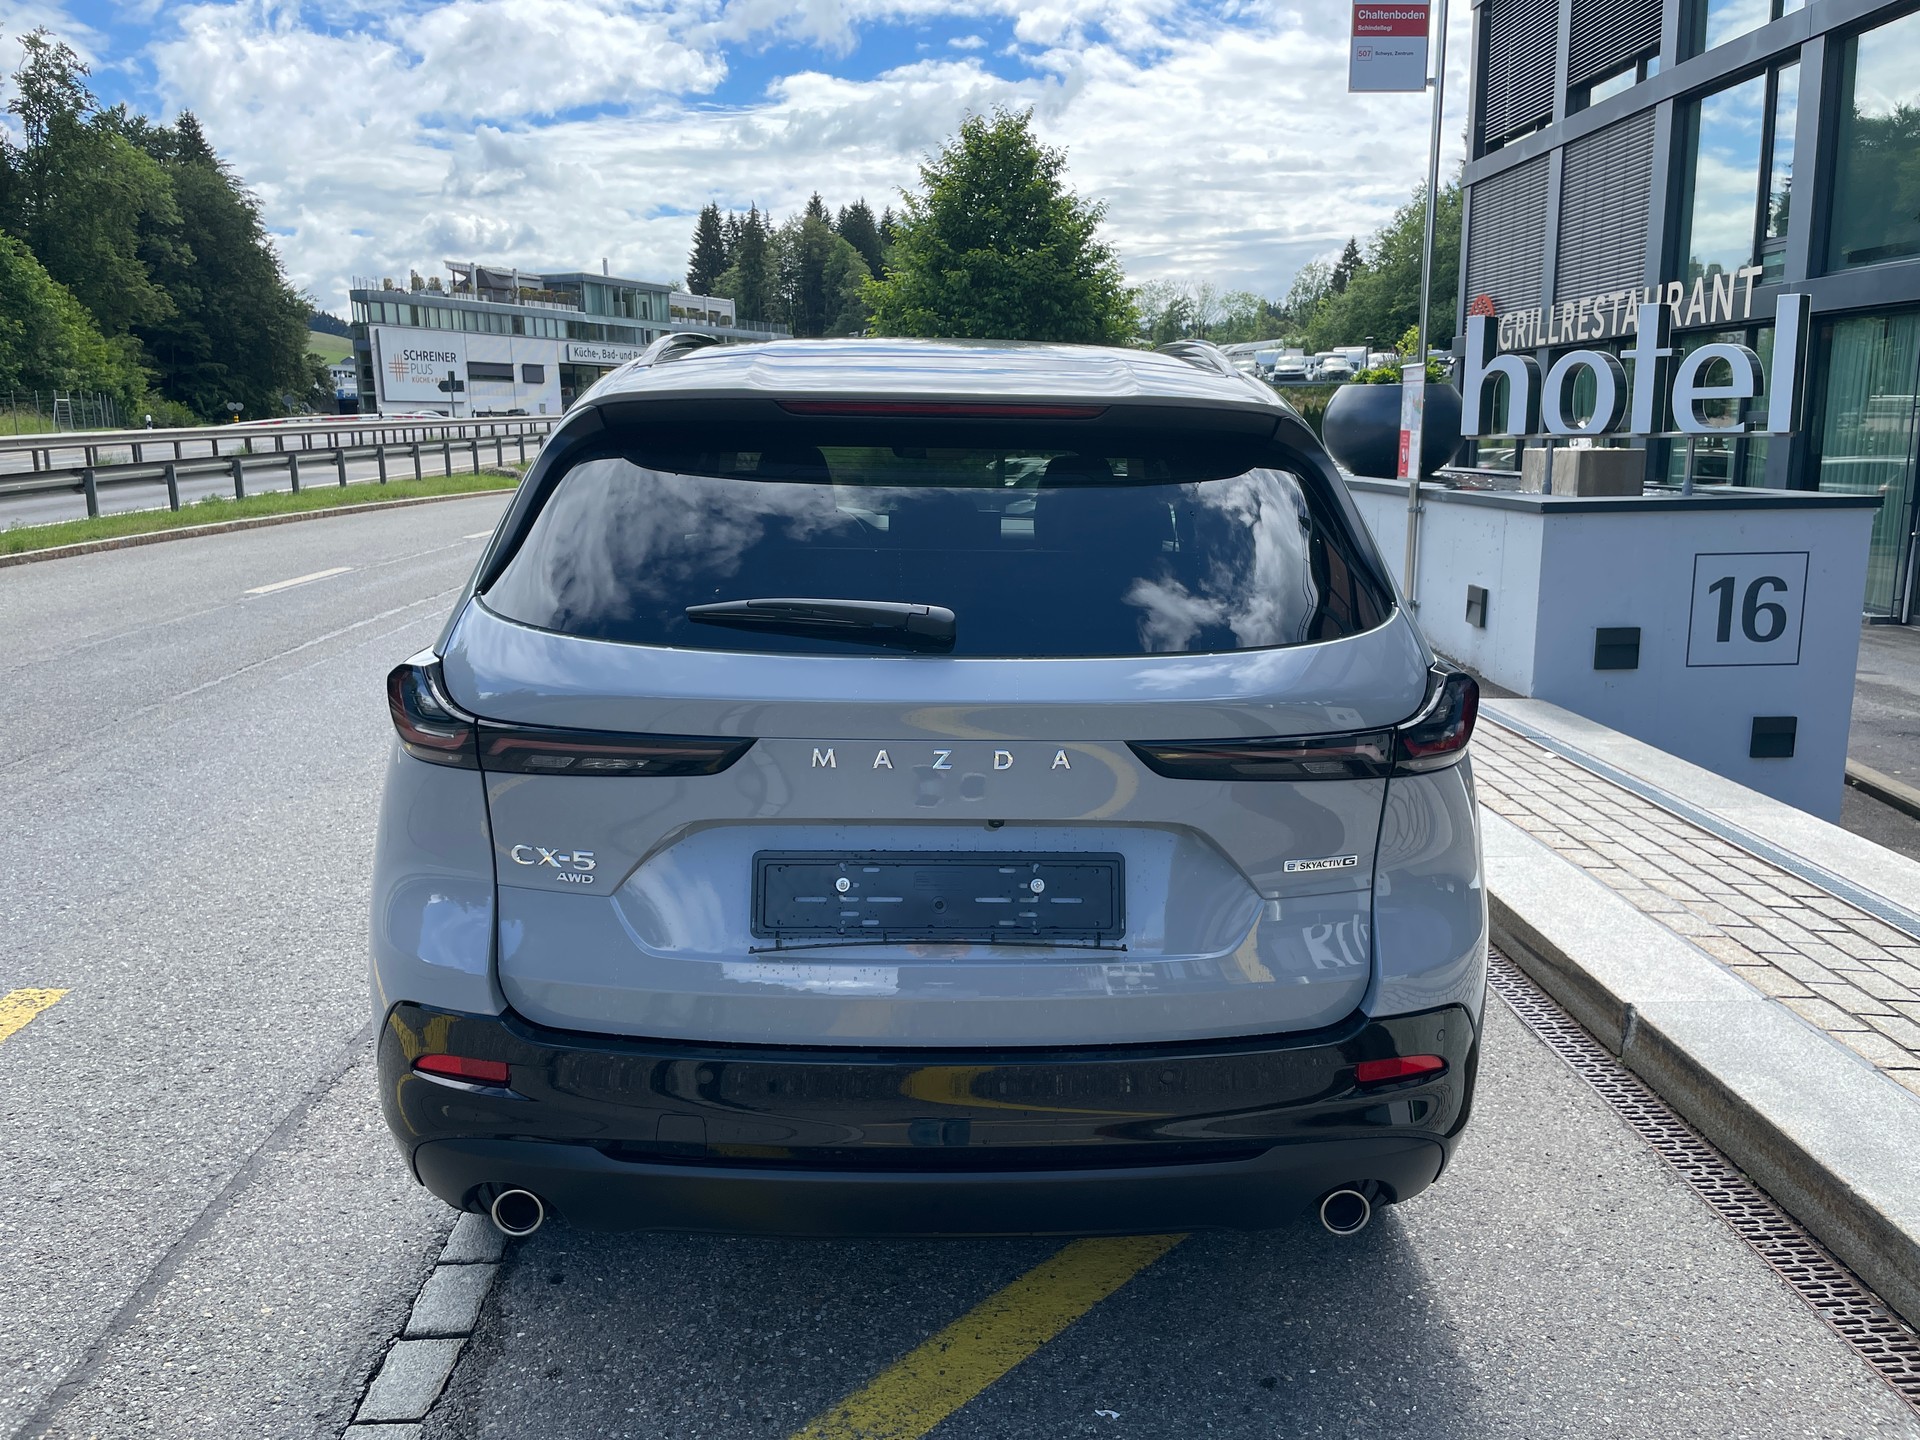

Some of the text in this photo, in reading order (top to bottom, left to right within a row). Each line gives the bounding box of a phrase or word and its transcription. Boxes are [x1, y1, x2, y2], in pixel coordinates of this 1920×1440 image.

[1358, 9, 1425, 20] Chaltenboden
[403, 349, 457, 363] SCHREINER
[602, 349, 618, 360] Bad-
[620, 350, 632, 361] und
[410, 363, 433, 375] PLUS
[1460, 293, 1811, 436] hotel
[412, 376, 430, 384] KÜCHE
[1708, 575, 1788, 643] 16
[811, 747, 1071, 770] MAZDA
[510, 844, 597, 871] CX-5
[556, 872, 594, 884] AWD
